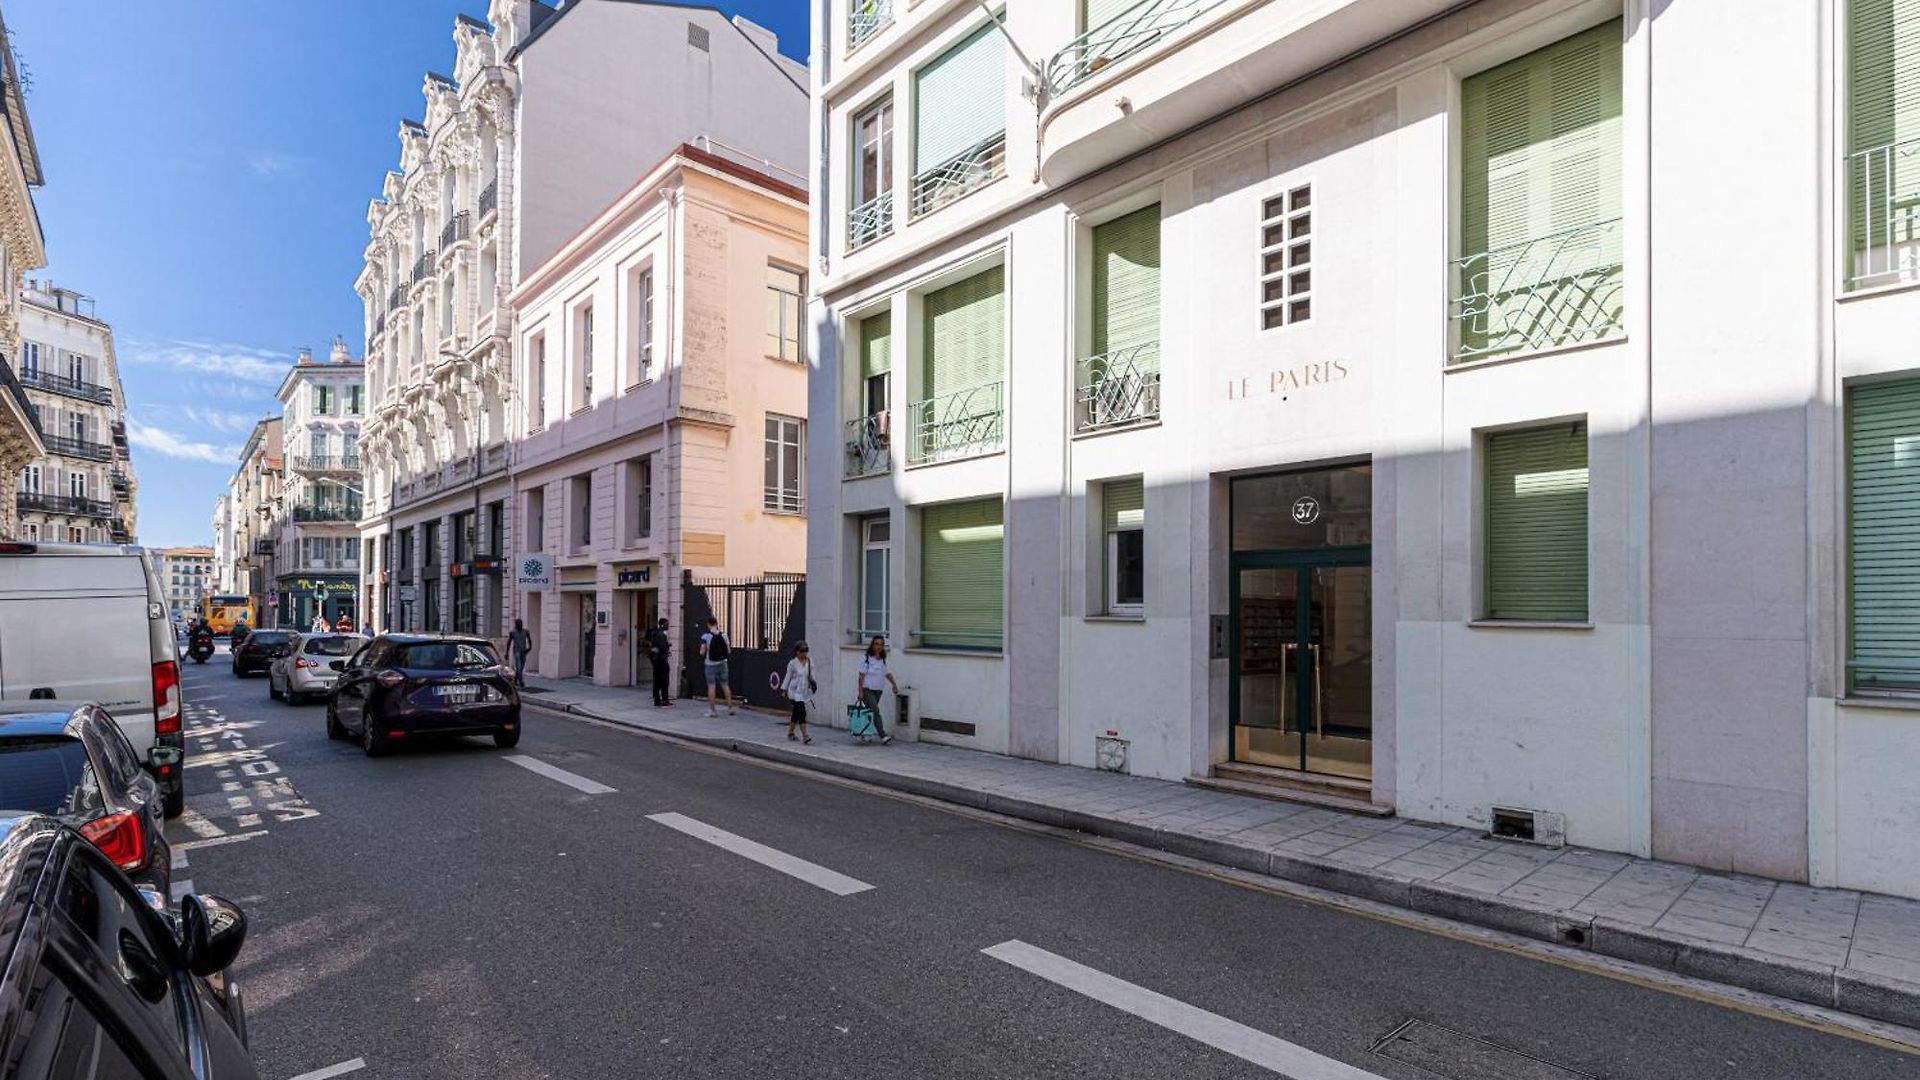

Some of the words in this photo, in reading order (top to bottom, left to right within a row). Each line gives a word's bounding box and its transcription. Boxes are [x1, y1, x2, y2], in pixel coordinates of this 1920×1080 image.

[1228, 376, 1252, 401] LE
[1270, 360, 1347, 393] PARIS
[1295, 502, 1314, 519] 37
[518, 577, 549, 585] picard
[618, 566, 650, 587] picard
